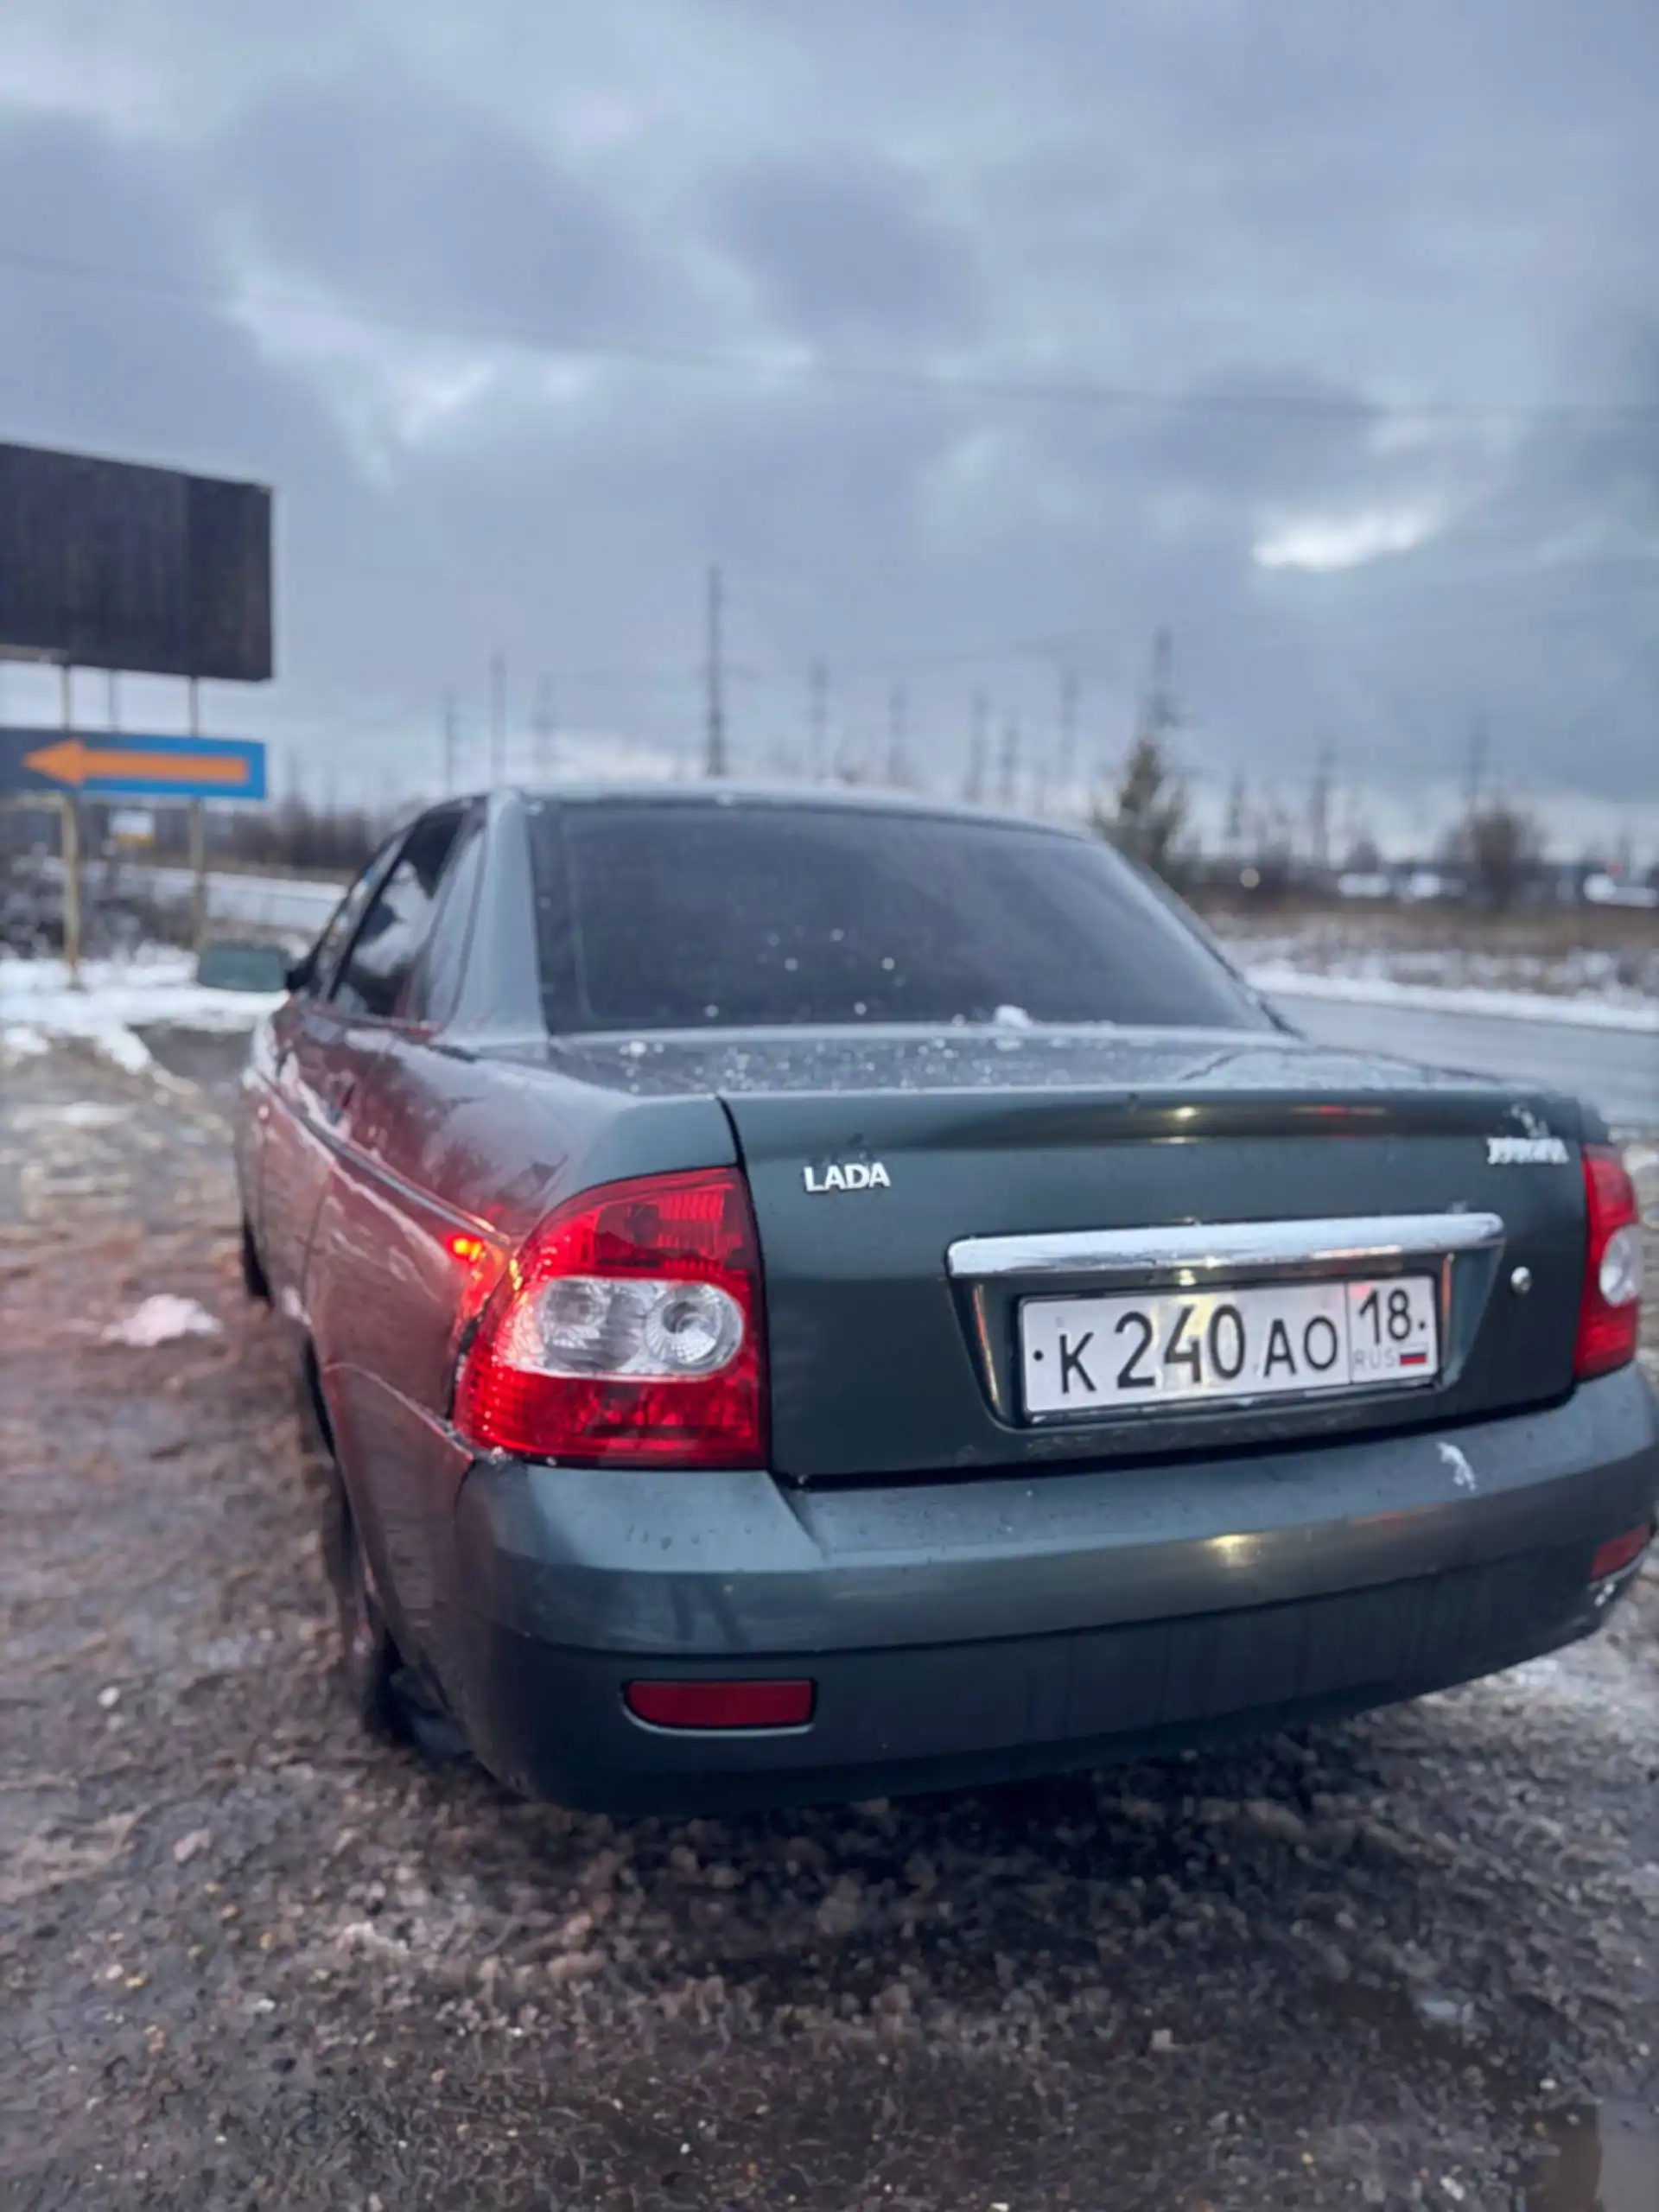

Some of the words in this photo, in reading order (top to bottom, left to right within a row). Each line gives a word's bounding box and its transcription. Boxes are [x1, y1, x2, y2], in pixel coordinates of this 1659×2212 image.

[804, 1162, 891, 1192] LADA
[1359, 1287, 1411, 1344] 18
[1115, 1304, 1245, 1389] 240
